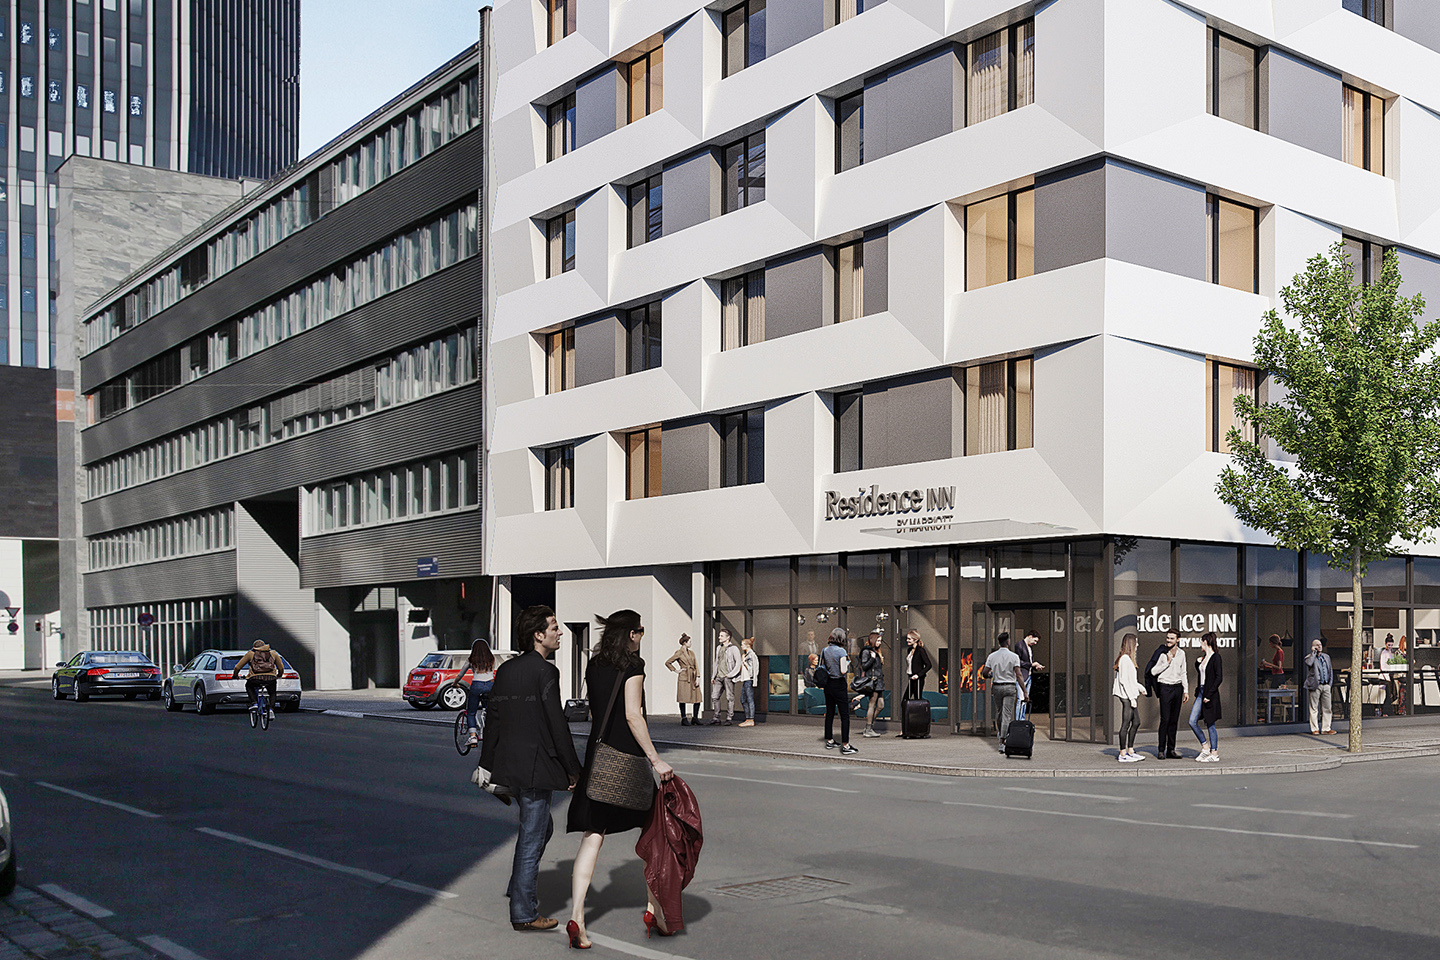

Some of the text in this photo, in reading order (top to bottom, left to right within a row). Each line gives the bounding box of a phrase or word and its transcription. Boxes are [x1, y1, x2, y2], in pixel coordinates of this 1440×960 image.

[825, 484, 957, 521] Residence INN
[1208, 613, 1237, 632] INN
[1179, 637, 1191, 648] BY
